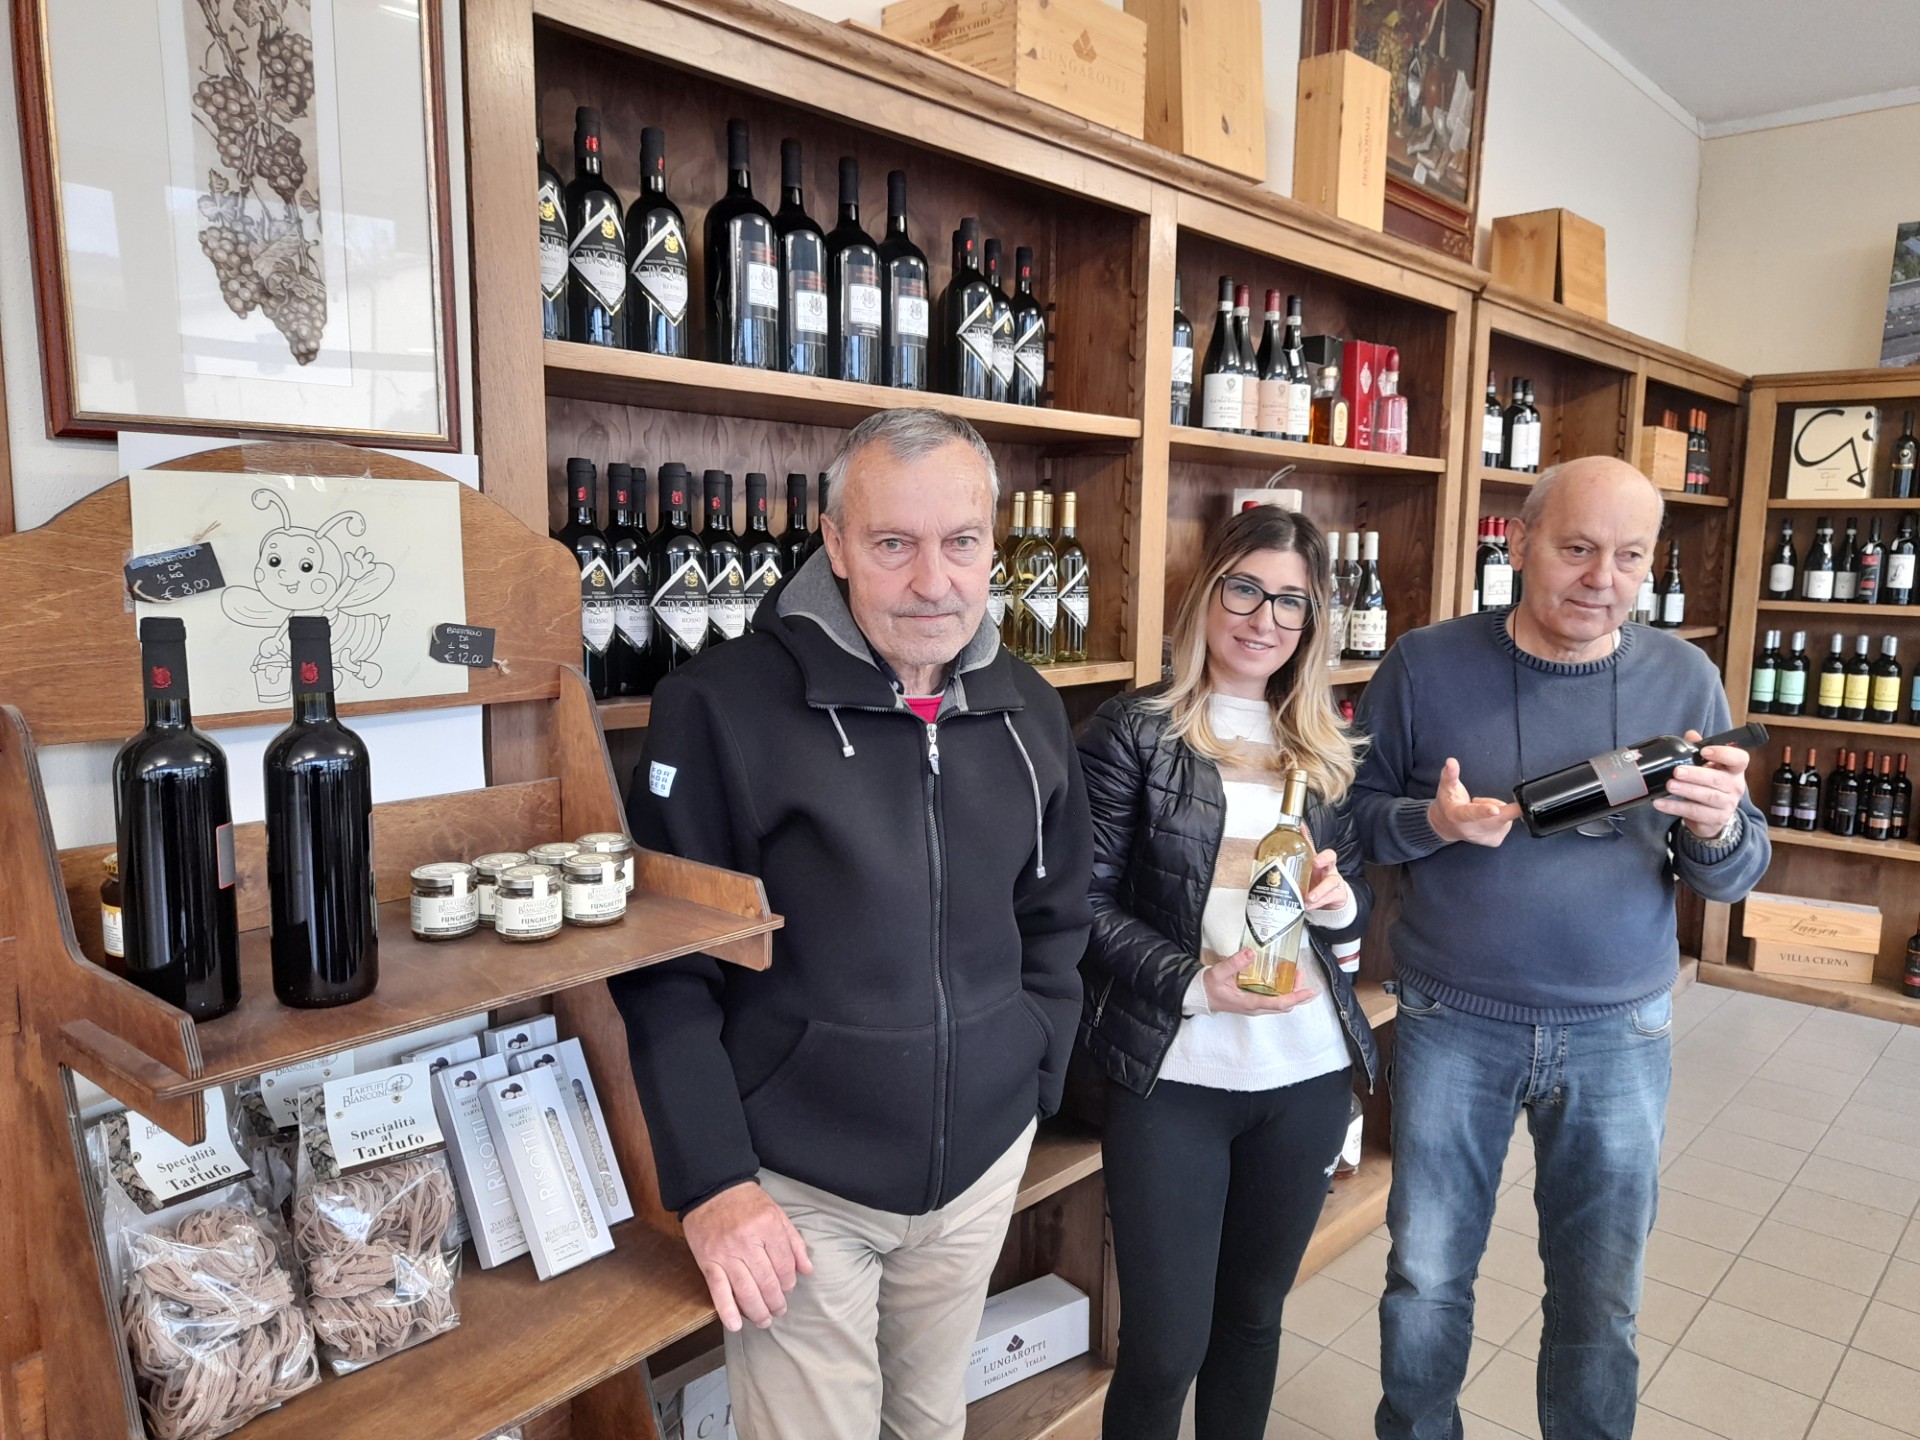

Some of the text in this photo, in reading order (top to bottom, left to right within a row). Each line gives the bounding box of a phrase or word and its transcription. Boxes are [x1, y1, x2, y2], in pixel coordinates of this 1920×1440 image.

[181, 578, 210, 595] 8,00
[657, 599, 702, 614] CINQUE
[590, 899, 623, 910] FUNGHETTO
[521, 913, 558, 925] FUNGHETTO
[1780, 952, 1850, 968] VILLA CERNA
[346, 1082, 385, 1096] TARTUFI
[342, 1089, 388, 1109] BIANCONI
[507, 1106, 533, 1118] RISOTTO
[350, 1115, 417, 1141] Specialità
[381, 1132, 393, 1142] al
[352, 1134, 425, 1161] Tartufo
[471, 1118, 507, 1192] RISOTTI
[156, 1146, 217, 1174] Specialità
[187, 1162, 200, 1174] al
[519, 1128, 562, 1201] RISOTTI
[165, 1164, 232, 1192] Tartufo
[982, 1340, 1047, 1375] LUNGAROTTI
[983, 1354, 1048, 1387] TORGIANO ITALIA
